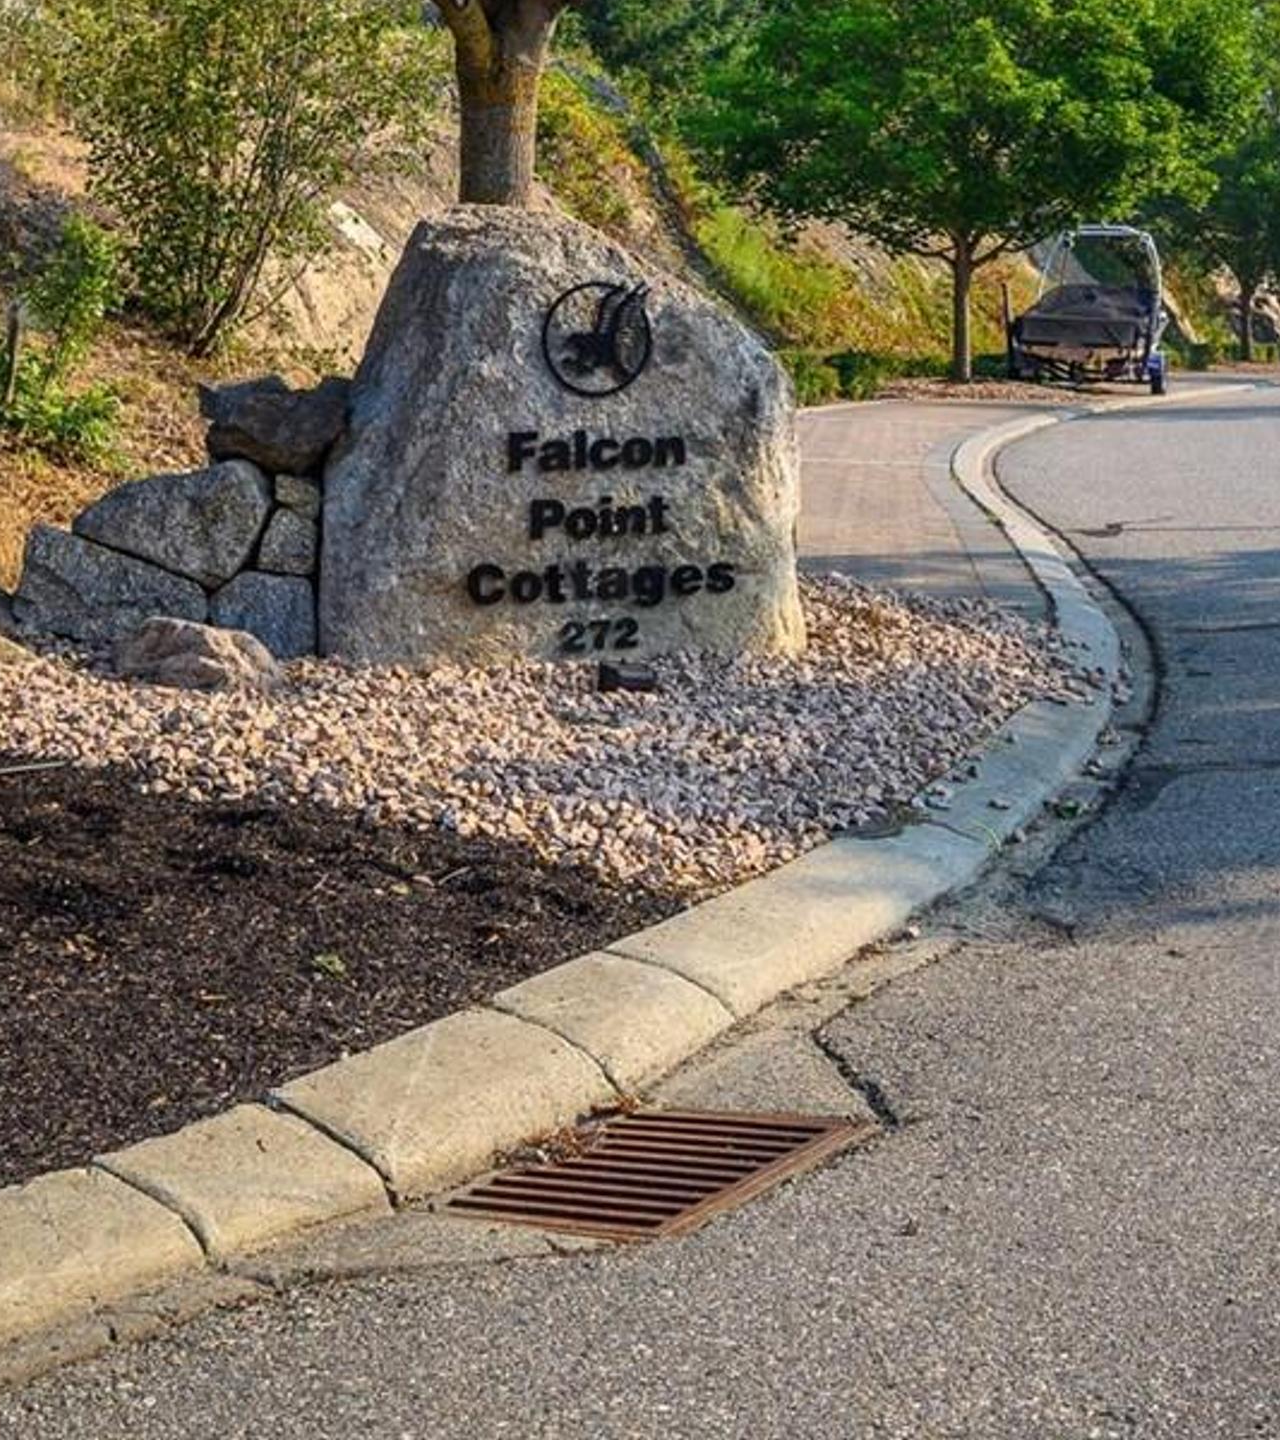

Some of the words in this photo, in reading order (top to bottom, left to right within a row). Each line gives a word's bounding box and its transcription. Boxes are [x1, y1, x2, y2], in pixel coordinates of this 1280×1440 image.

[507, 430, 687, 474] Falcon
[528, 495, 671, 540] Point
[467, 561, 736, 607] Cottages
[559, 617, 640, 653] 272
